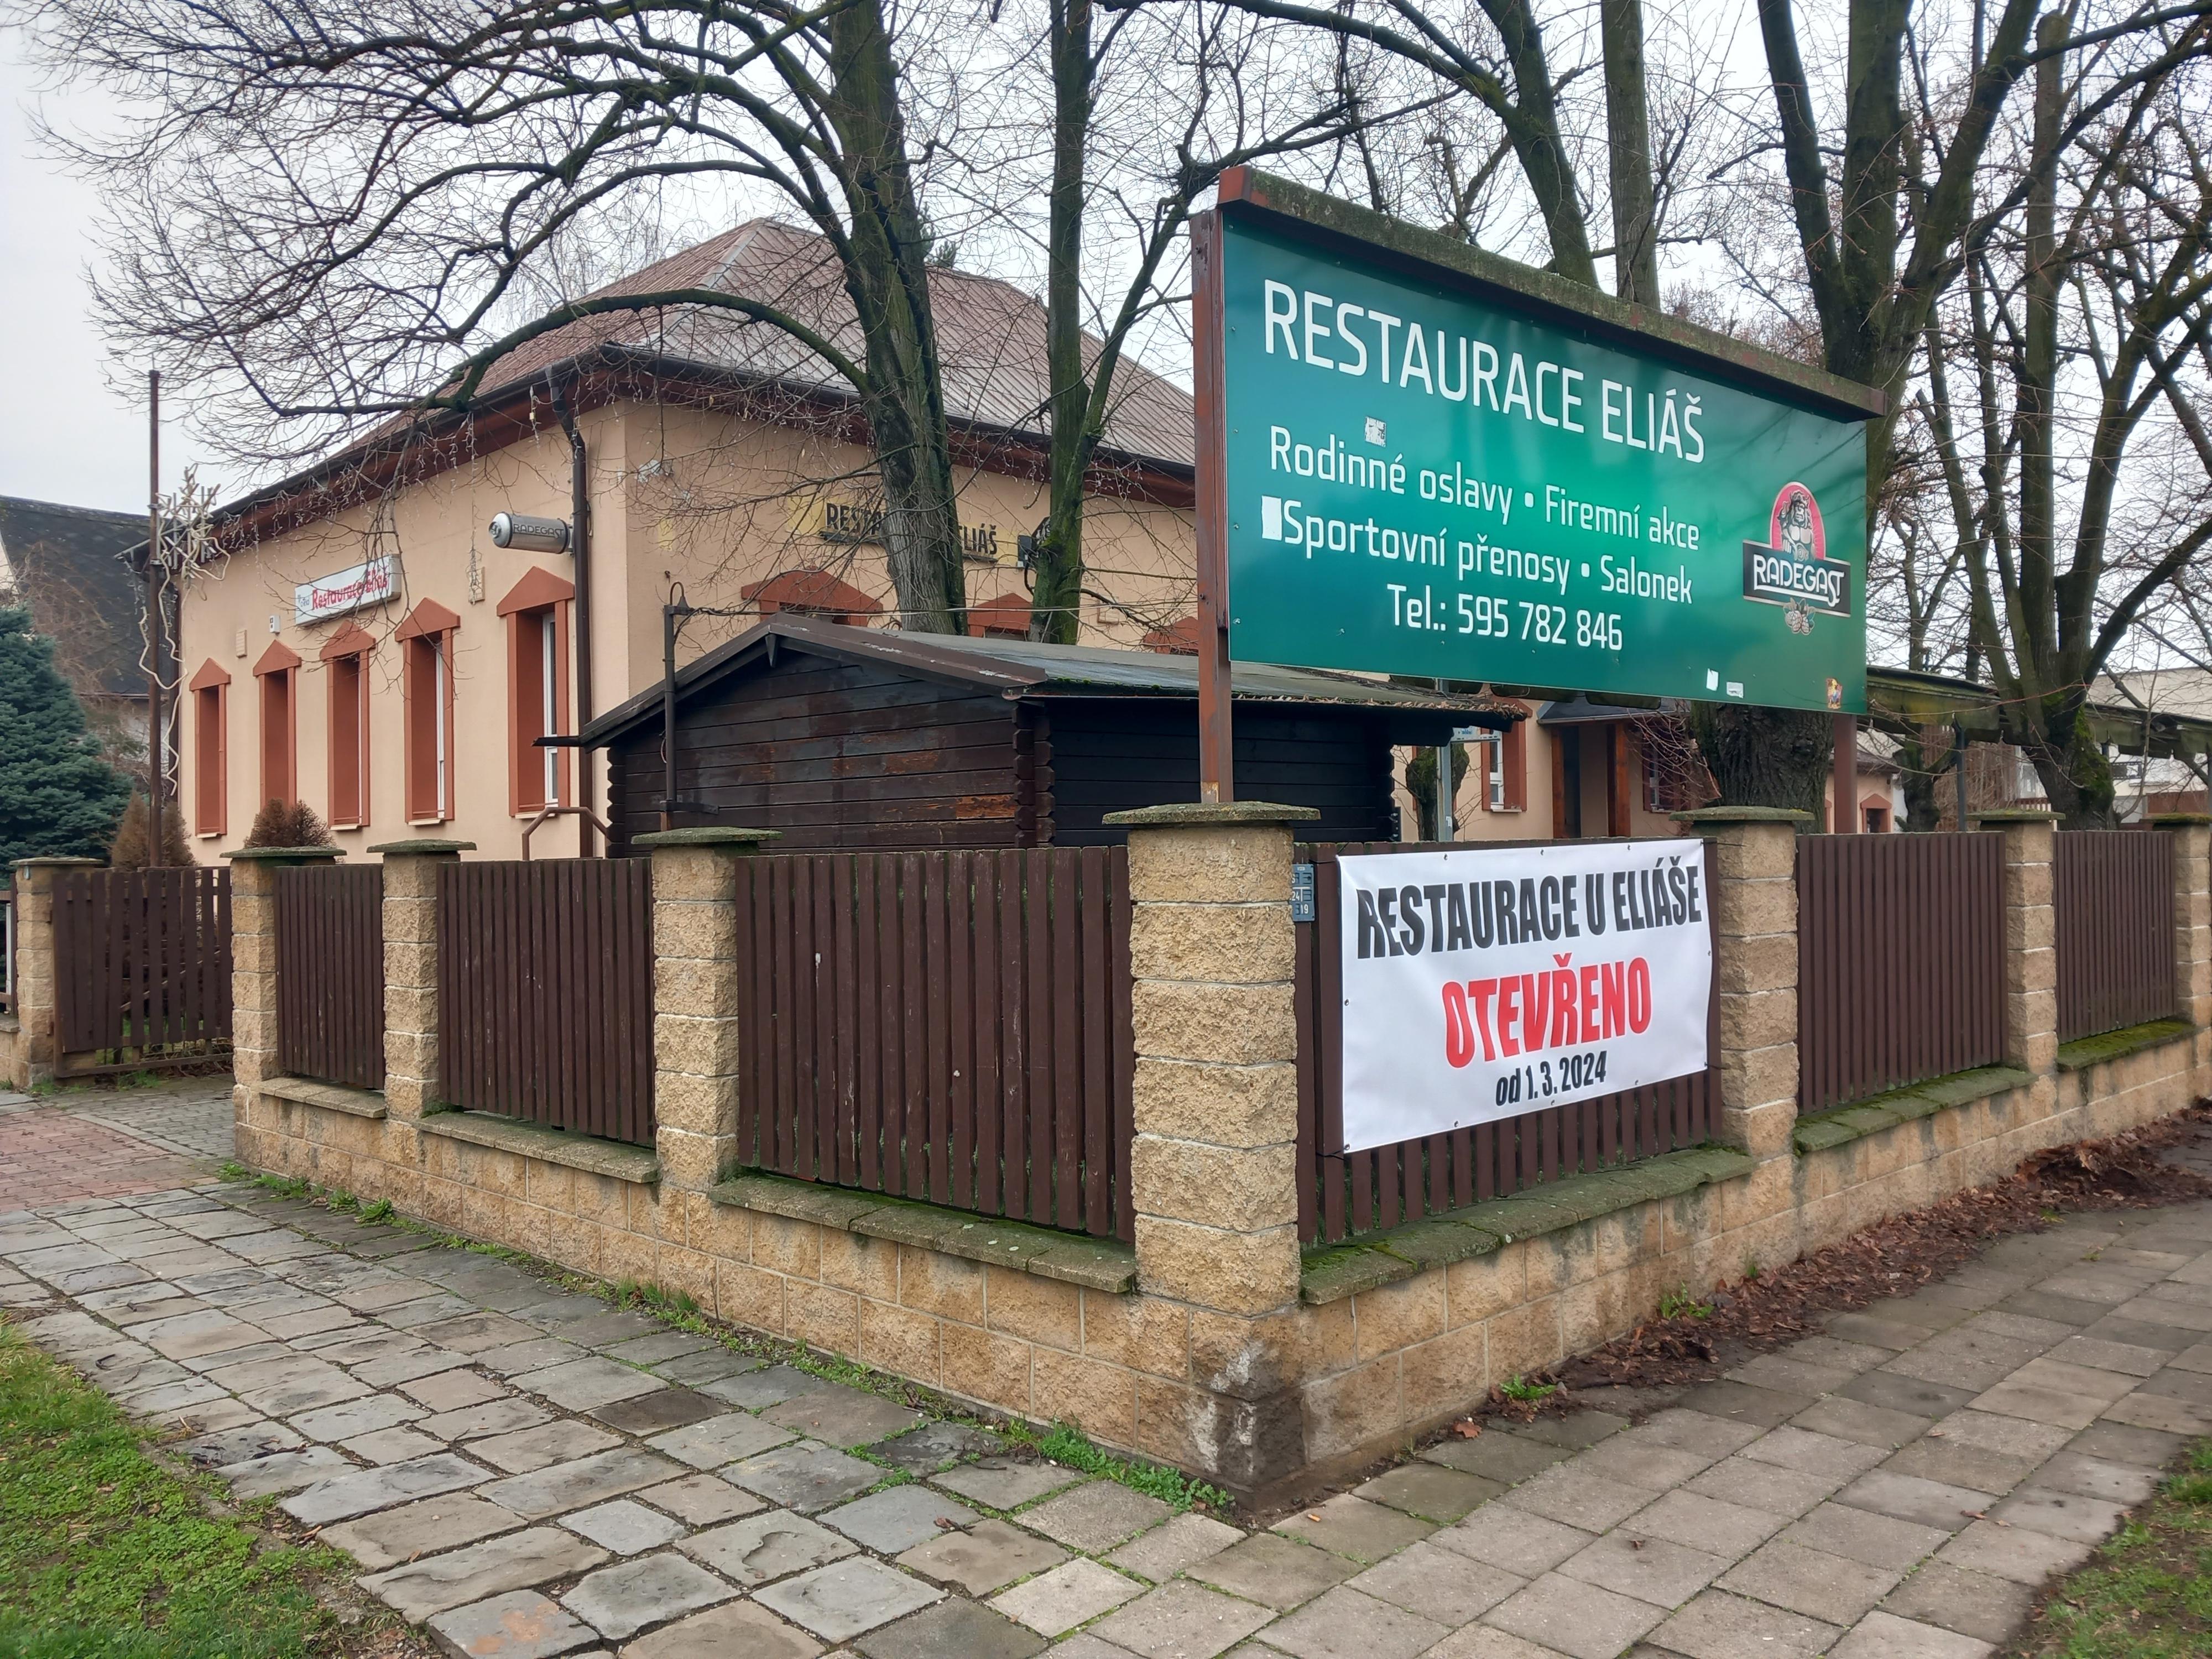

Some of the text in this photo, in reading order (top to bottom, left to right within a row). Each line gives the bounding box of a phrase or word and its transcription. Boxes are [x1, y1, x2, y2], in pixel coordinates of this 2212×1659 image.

[1265, 279, 1704, 463] RESTAURACE ELIÁŠ
[1271, 425, 1406, 494] Rodinné
[1420, 461, 1513, 525] oslavy
[1546, 484, 1641, 539] Firemní
[1648, 506, 1700, 550] akce
[513, 524, 564, 539] RADEGAST
[958, 523, 997, 555] LIÁŠ
[1284, 499, 1692, 604] Sportovní přenosy Salonek
[1387, 583, 1623, 651] Tel.: 595 782 846
[1753, 554, 1845, 608] RADEGAST
[1357, 855, 1702, 959] RESTAURACE U ELIÁŠE
[1442, 952, 1652, 1068] OTEVŘENO
[1496, 1068, 1521, 1107] od
